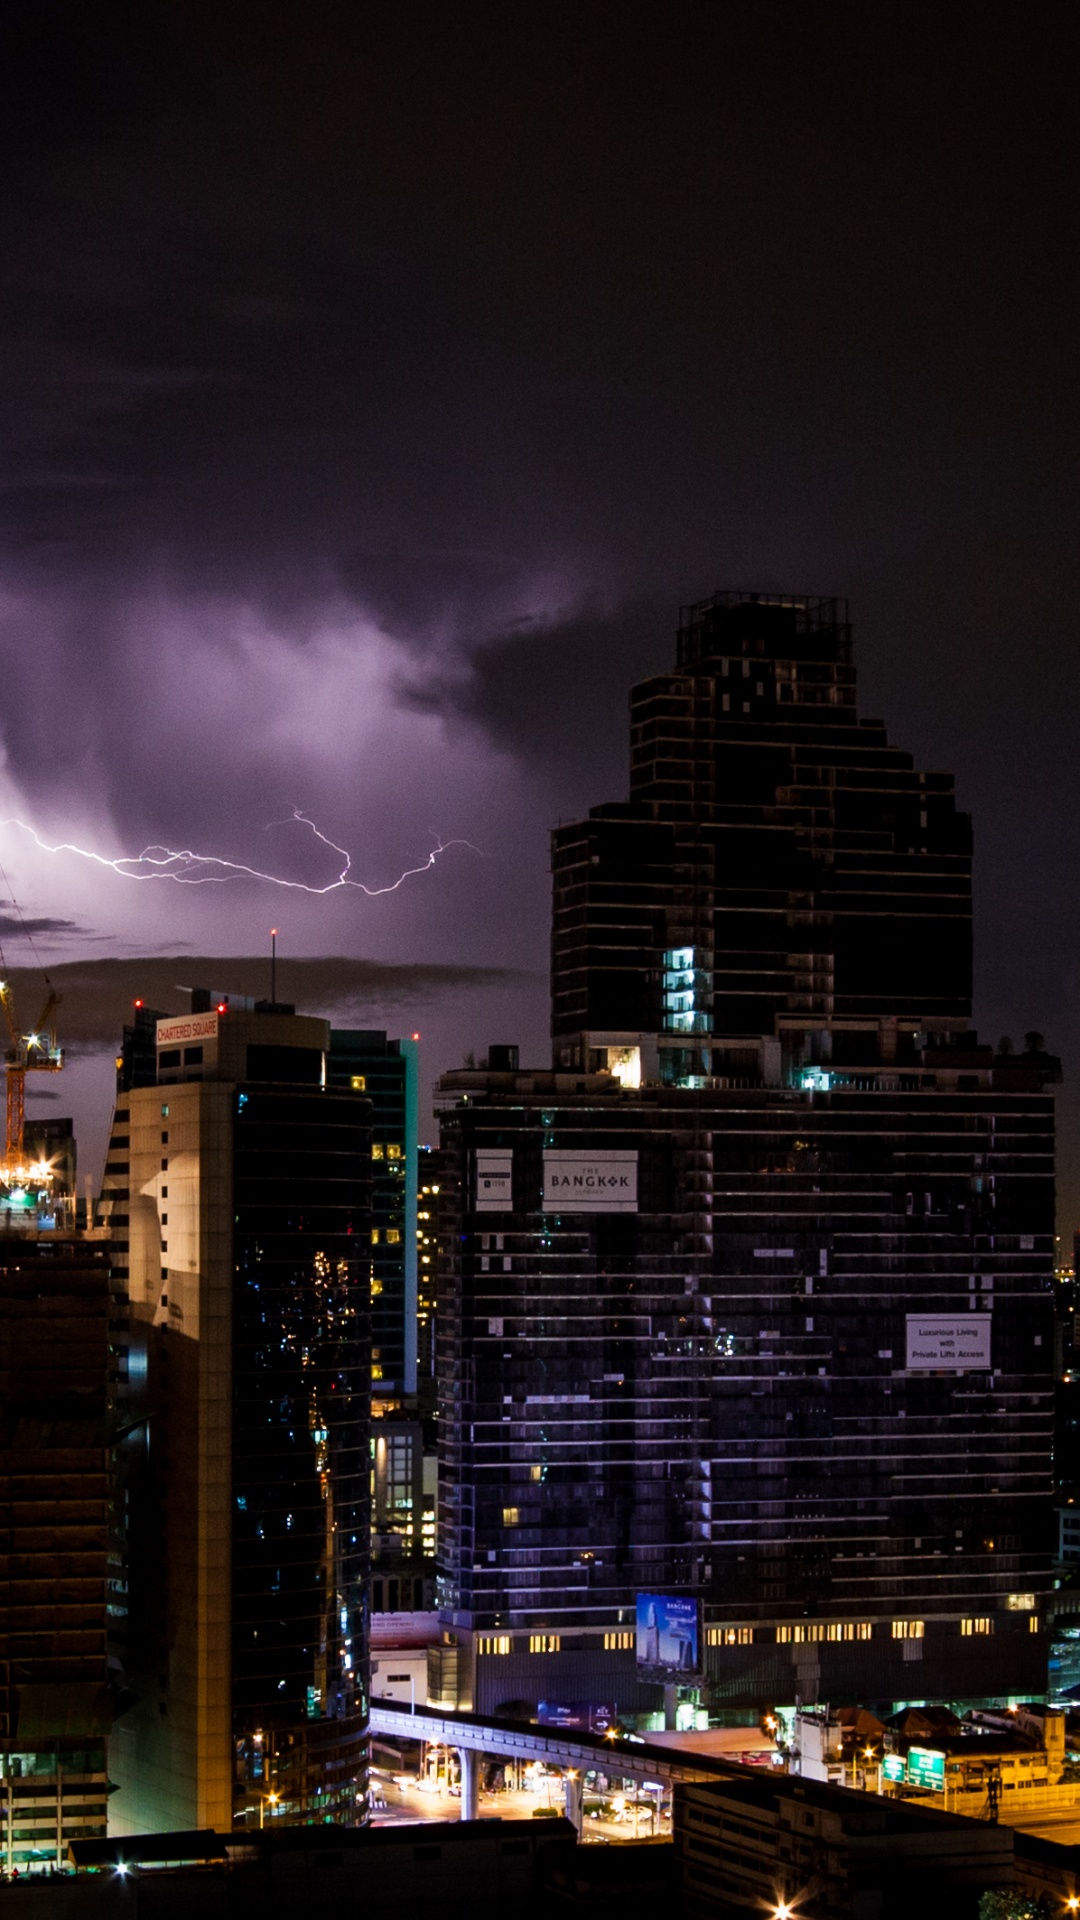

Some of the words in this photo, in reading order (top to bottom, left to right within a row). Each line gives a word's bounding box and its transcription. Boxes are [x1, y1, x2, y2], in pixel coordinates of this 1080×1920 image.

[158, 1024, 191, 1041] CHARTERED
[193, 1020, 217, 1037] SQUARE
[957, 1329, 978, 1337] Living
